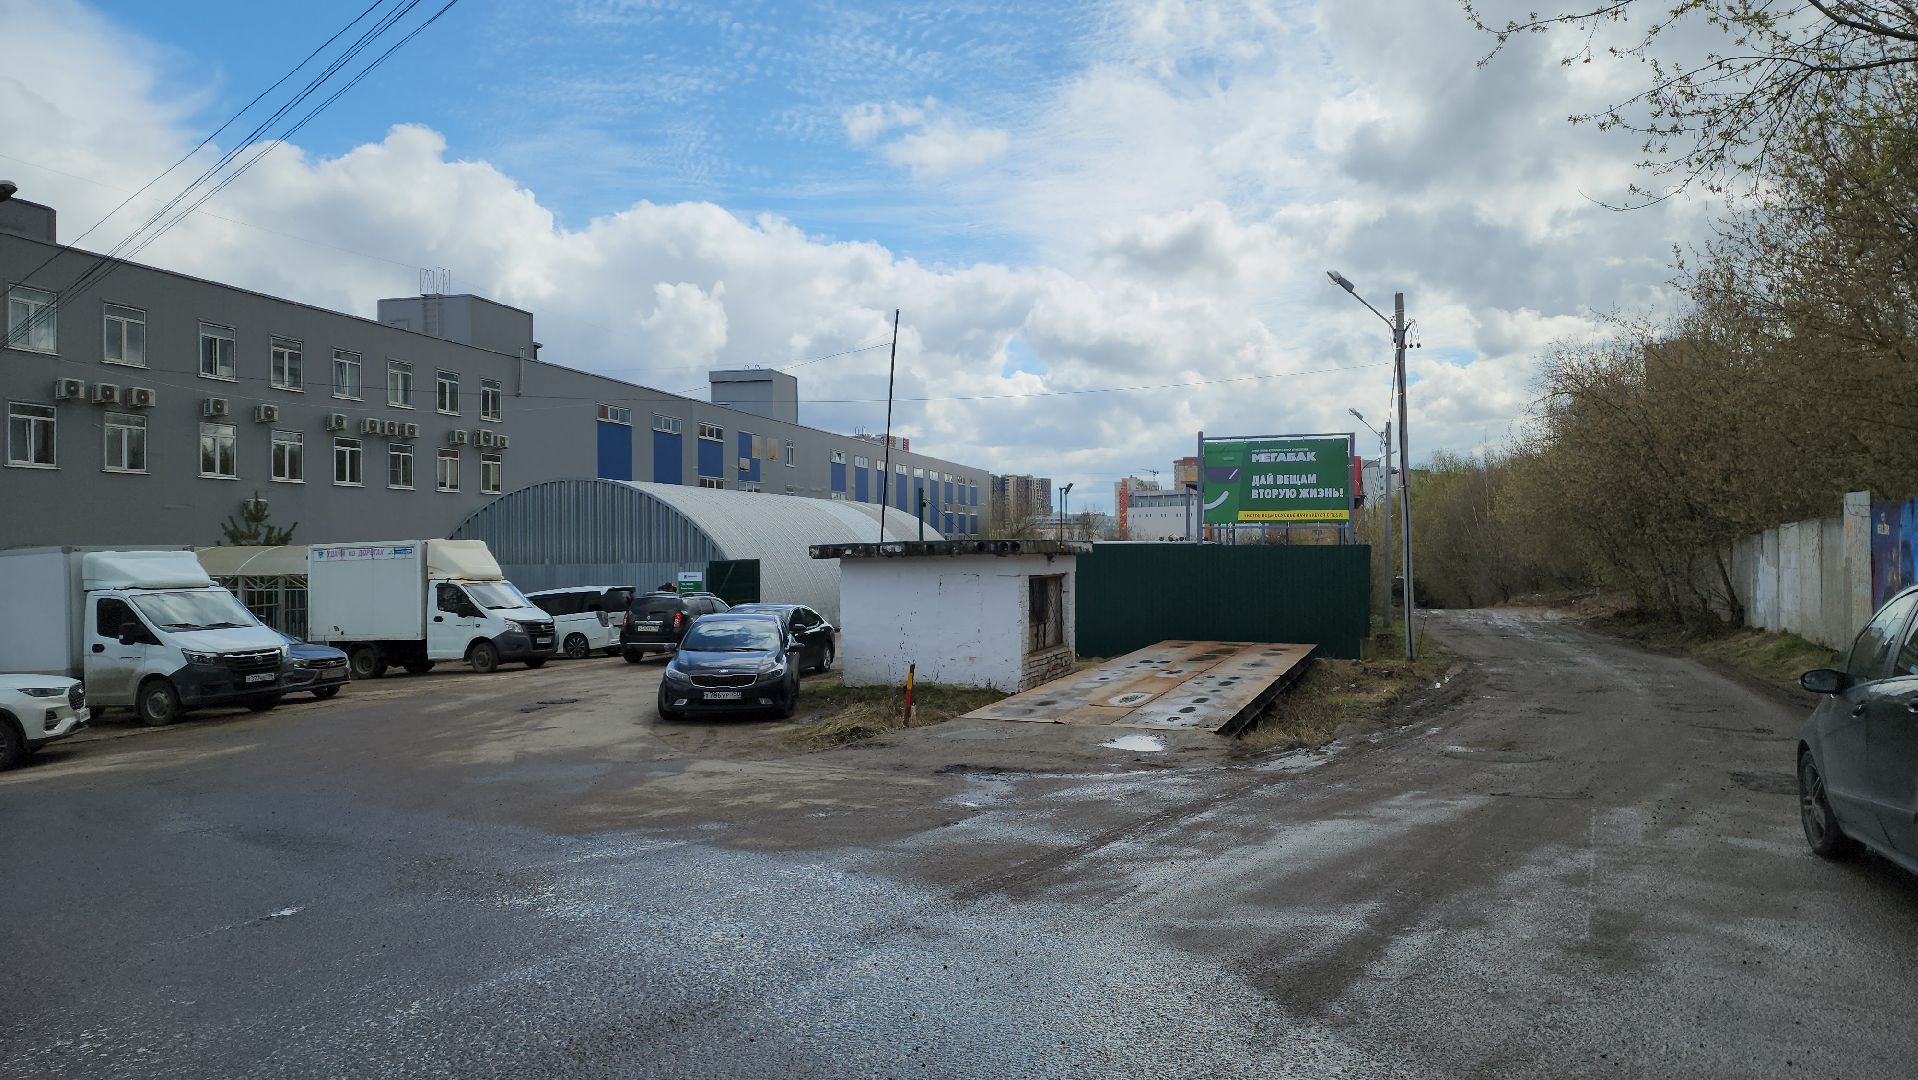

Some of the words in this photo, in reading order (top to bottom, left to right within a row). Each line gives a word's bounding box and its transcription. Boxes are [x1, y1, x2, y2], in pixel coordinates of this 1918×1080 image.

[1251, 452, 1316, 463] МЕГАБАК
[1252, 473, 1274, 486] ДАЙ
[1276, 474, 1316, 485] ВЕЩАМ
[1251, 488, 1297, 499] ВТОРУЮ
[1299, 487, 1344, 498] ЖИЗНЬ!
